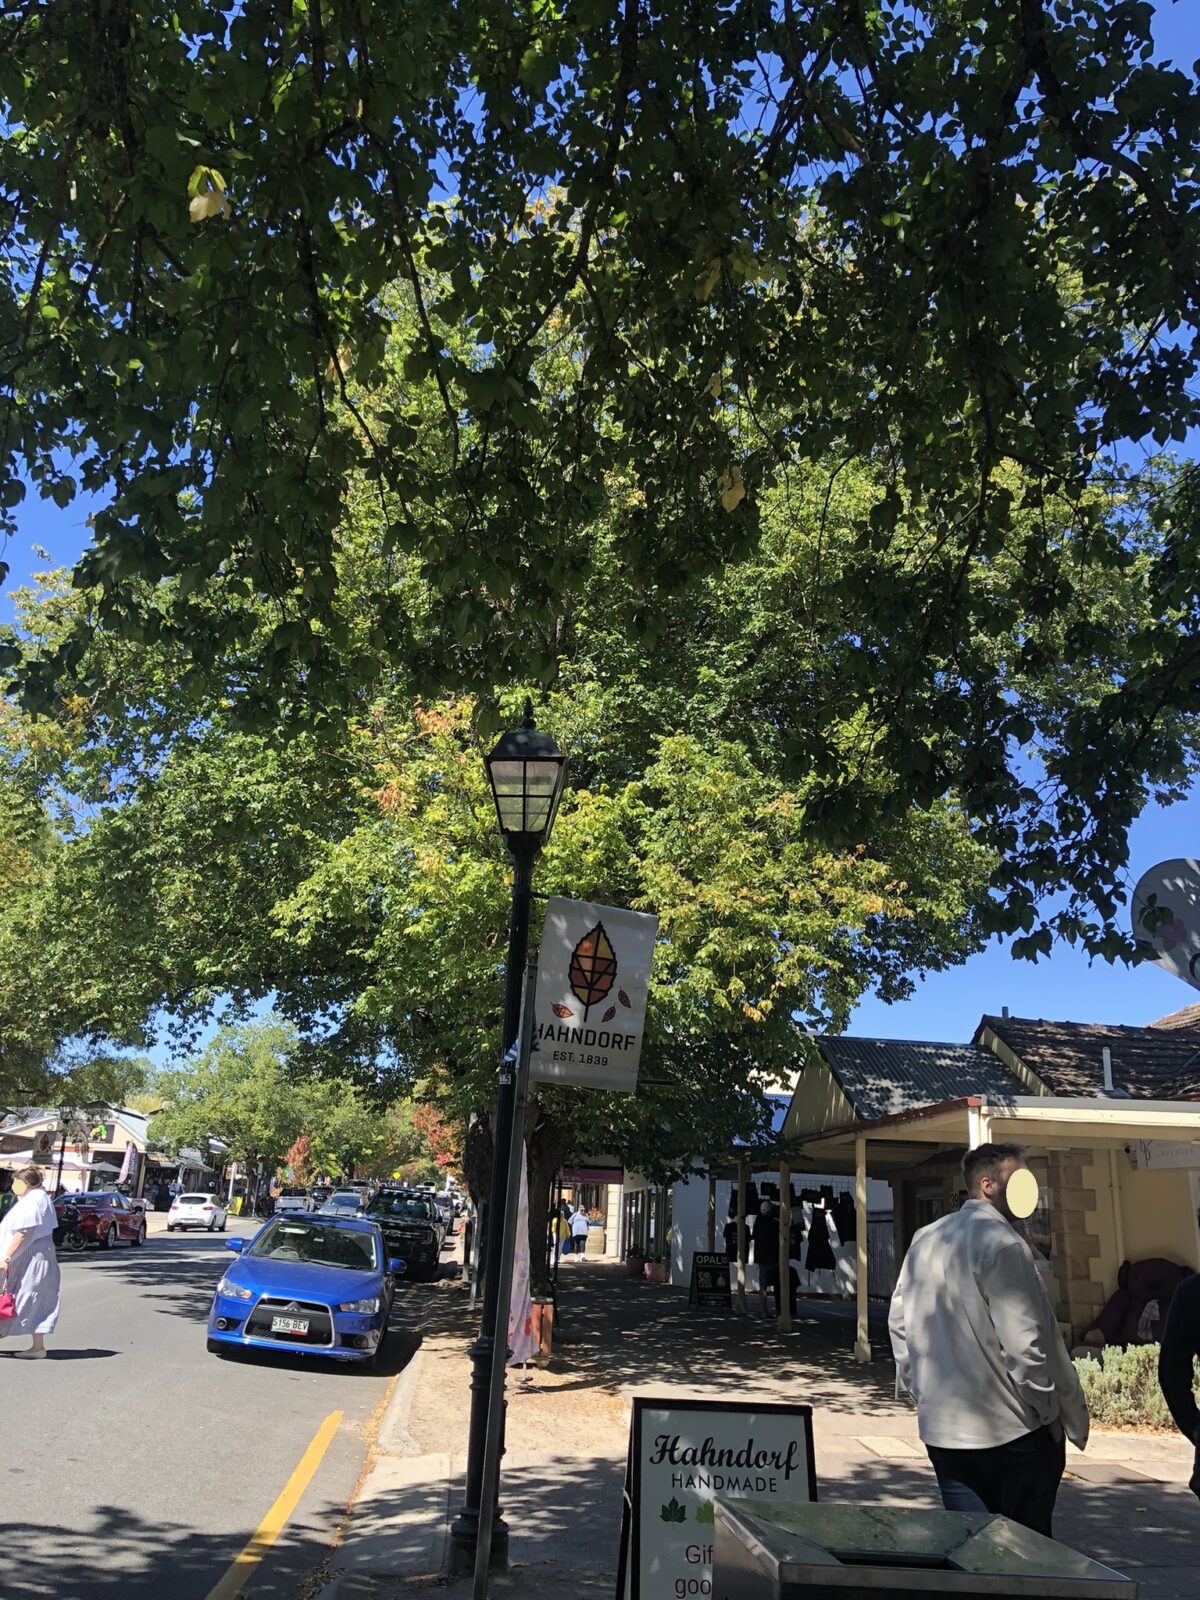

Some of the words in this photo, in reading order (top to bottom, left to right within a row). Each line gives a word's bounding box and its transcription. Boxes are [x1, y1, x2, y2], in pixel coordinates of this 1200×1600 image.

[553, 1050, 575, 1062] EST.
[579, 1053, 608, 1066] 1839
[649, 1434, 799, 1481] Hahndorf
[671, 1472, 778, 1492] HANDMADE
